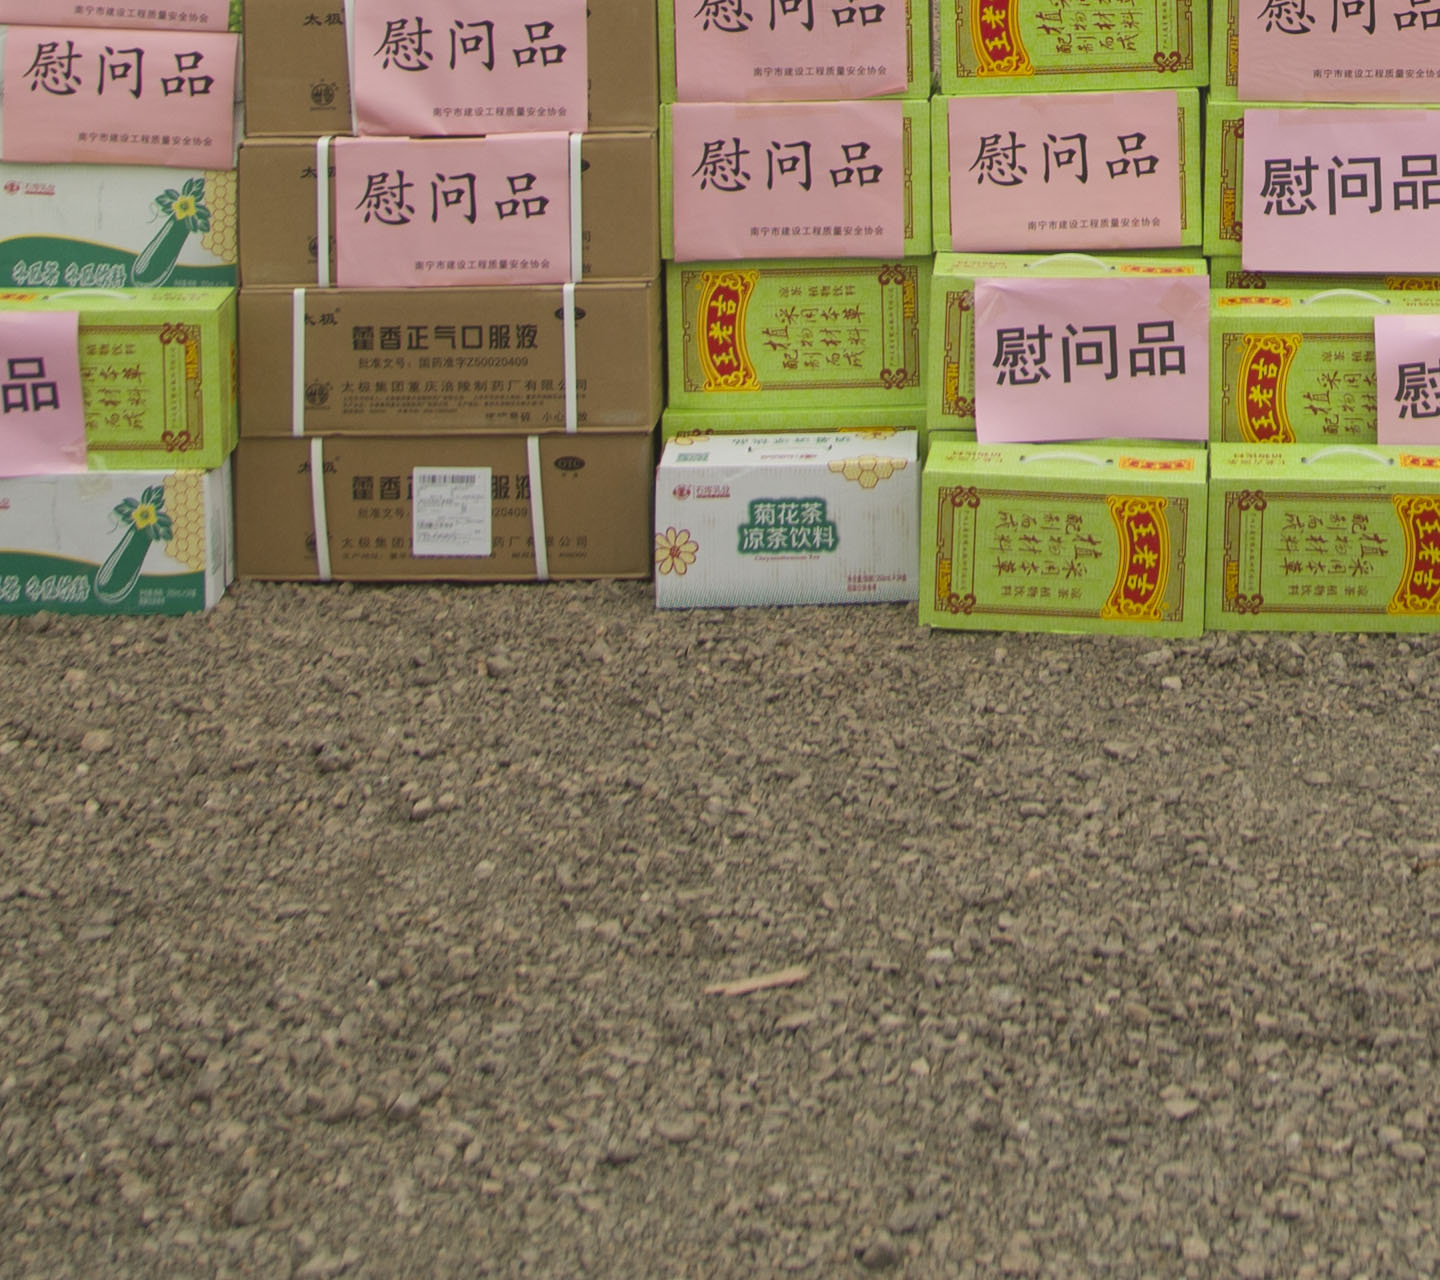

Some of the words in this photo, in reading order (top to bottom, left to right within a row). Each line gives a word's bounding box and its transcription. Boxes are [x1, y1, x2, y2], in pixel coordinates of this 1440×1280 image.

[71, 3, 210, 25] 南宁市建设工程质量安全协会
[374, 17, 566, 71] 慰问品
[24, 41, 214, 99] 慰问品
[753, 65, 887, 77] 南宁市建设工程质量安全协会
[432, 106, 567, 118] 南宁市建设工程质量安全协会
[78, 131, 213, 147] 南宁市建设工程质量安全协会
[692, 138, 883, 191] 慰问品
[969, 132, 1158, 186] 慰问品
[356, 170, 549, 225] 慰问品
[750, 225, 884, 237] 南宁市建设工程质量安全协会
[1027, 216, 1161, 231] 南宁市建设工程质量安全协会
[415, 258, 550, 271] 南宁市建设工程质量安全协会
[352, 323, 538, 351] 藿香正气口服液
[713, 297, 738, 374] 王老吉
[993, 321, 1185, 385] 慰问品
[1250, 359, 1281, 442] 王老吉
[754, 502, 823, 525] 菊花茶
[743, 526, 836, 550] 凉茶饮料
[1126, 512, 1156, 608] 王老吉
